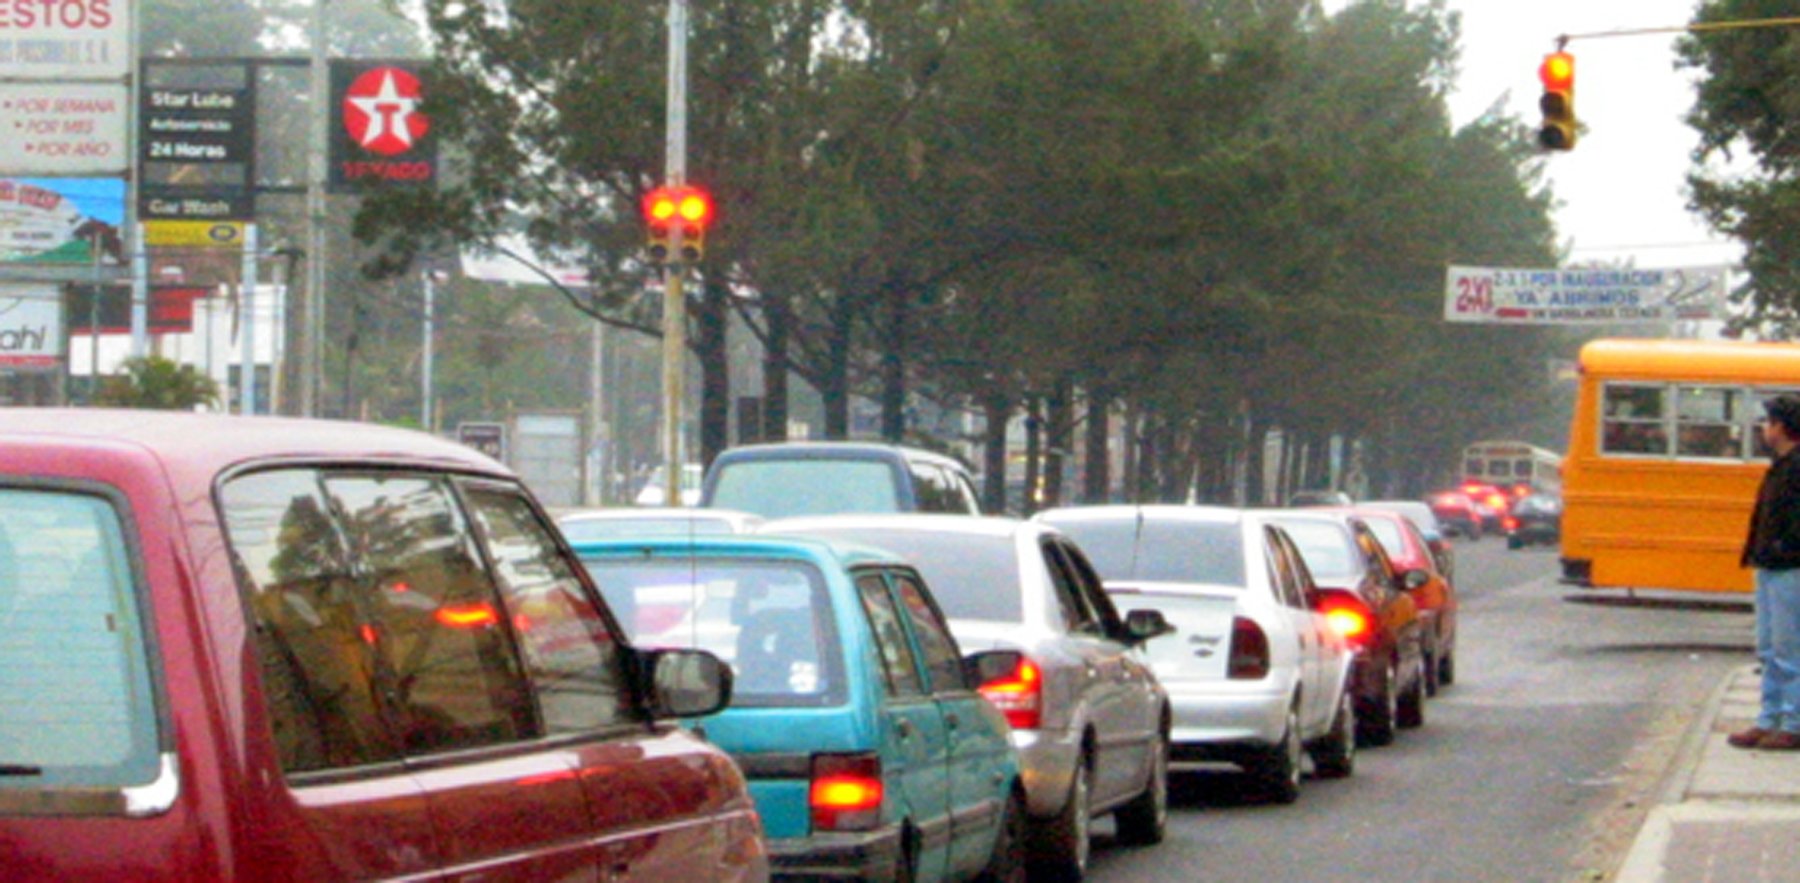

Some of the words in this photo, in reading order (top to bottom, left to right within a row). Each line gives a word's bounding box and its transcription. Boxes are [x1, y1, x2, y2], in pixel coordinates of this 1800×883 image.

[151, 92, 188, 107] Star
[151, 141, 171, 157] 24
[174, 141, 226, 158] Horas
[150, 199, 179, 214] Car
